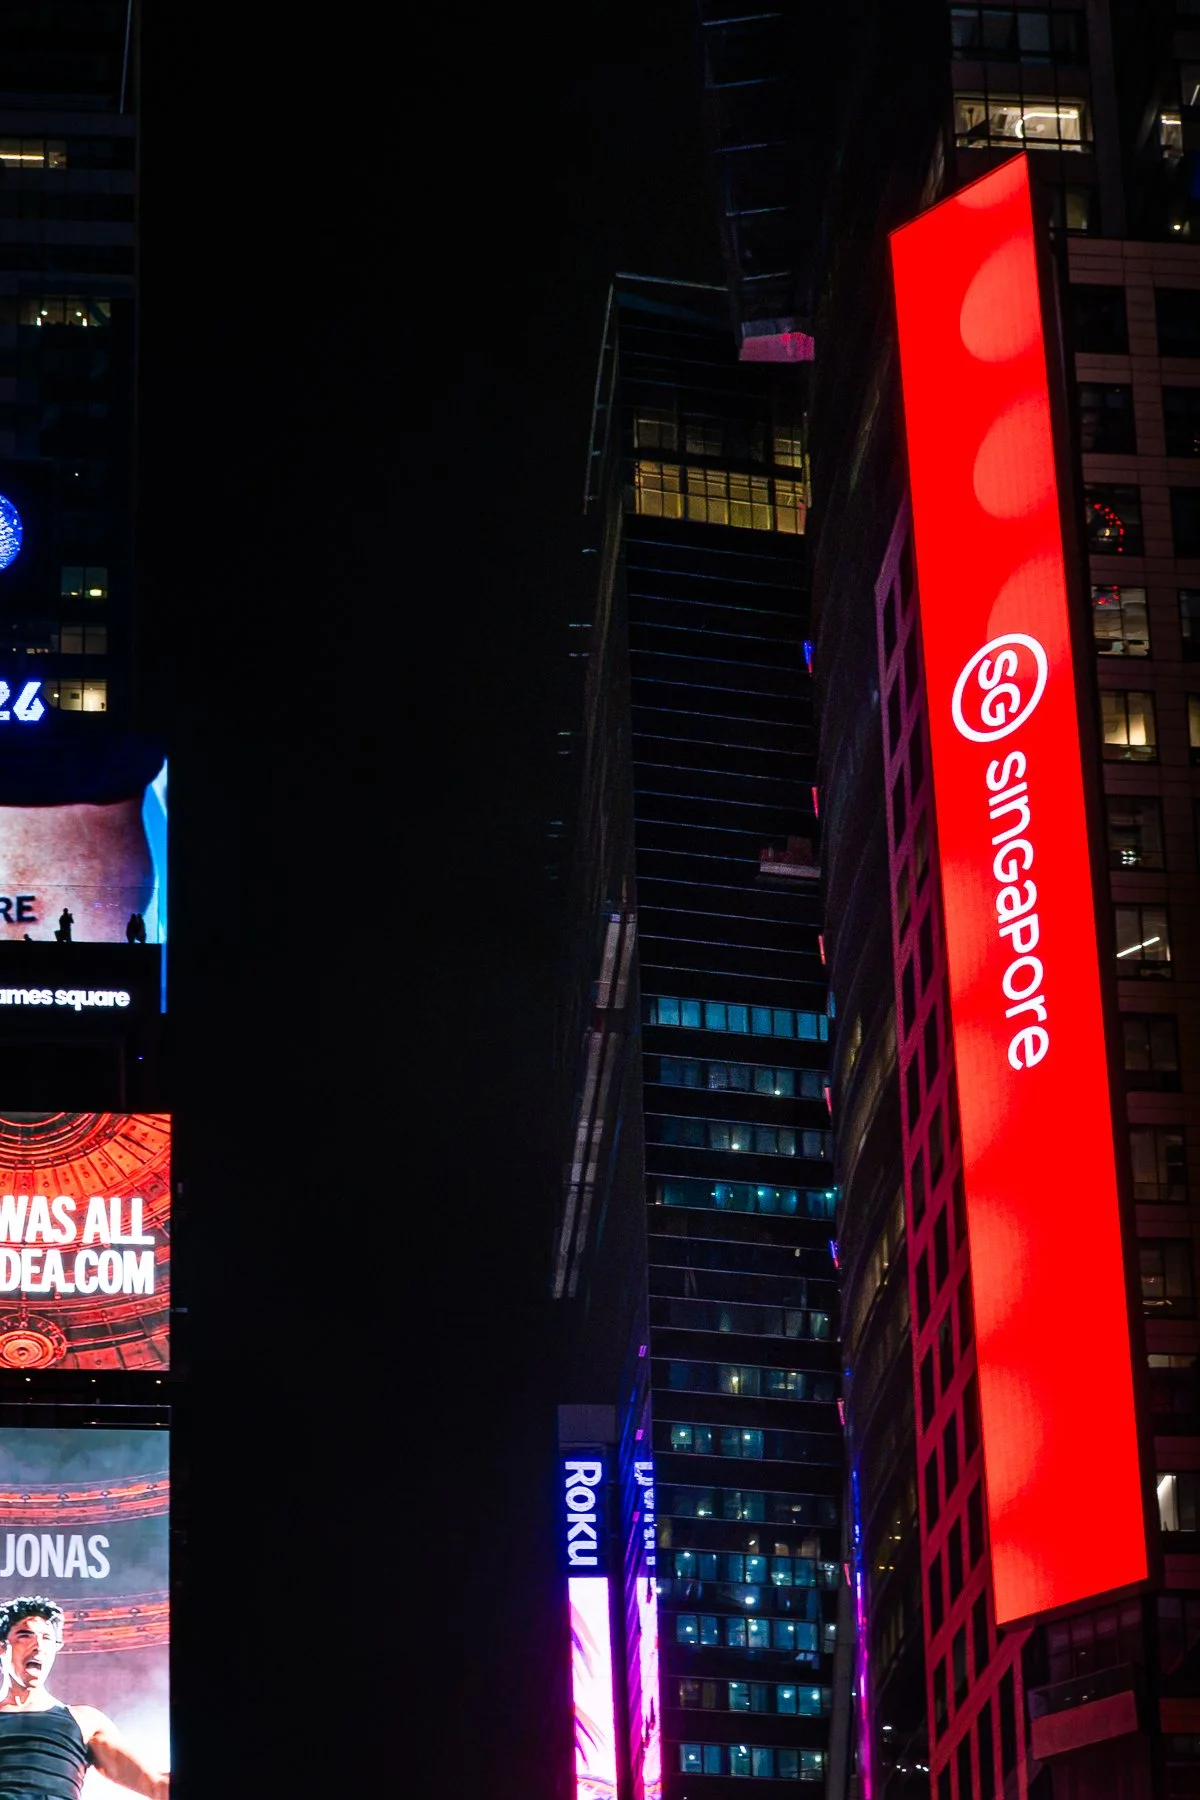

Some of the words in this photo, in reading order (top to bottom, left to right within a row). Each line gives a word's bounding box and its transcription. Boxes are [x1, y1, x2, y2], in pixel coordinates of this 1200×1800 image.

[53, 988, 131, 1012] square
[81, 1196, 156, 1246] ALL
[0, 1533, 111, 1579] JONAS
